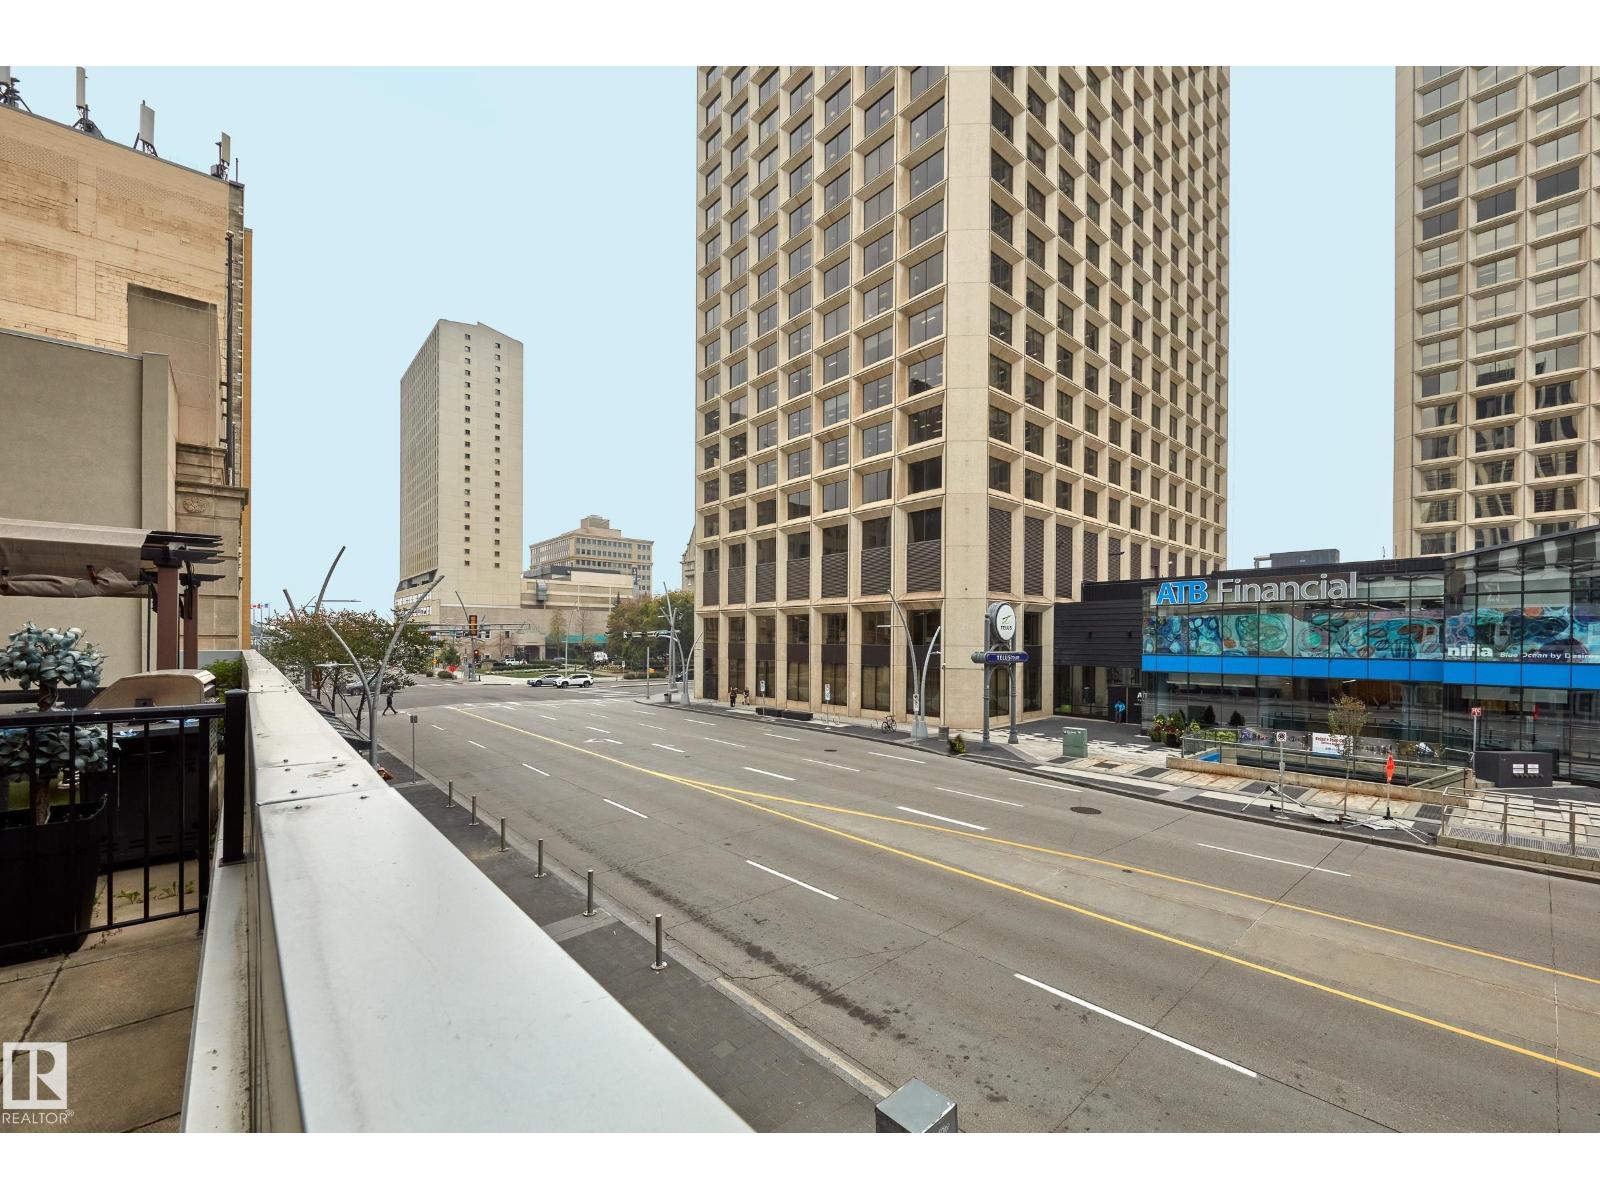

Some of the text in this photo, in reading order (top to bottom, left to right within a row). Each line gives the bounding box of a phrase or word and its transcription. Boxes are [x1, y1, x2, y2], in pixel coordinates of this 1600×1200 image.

[1156, 571, 1357, 605] ATB Financial
[1550, 652, 1562, 660] by
